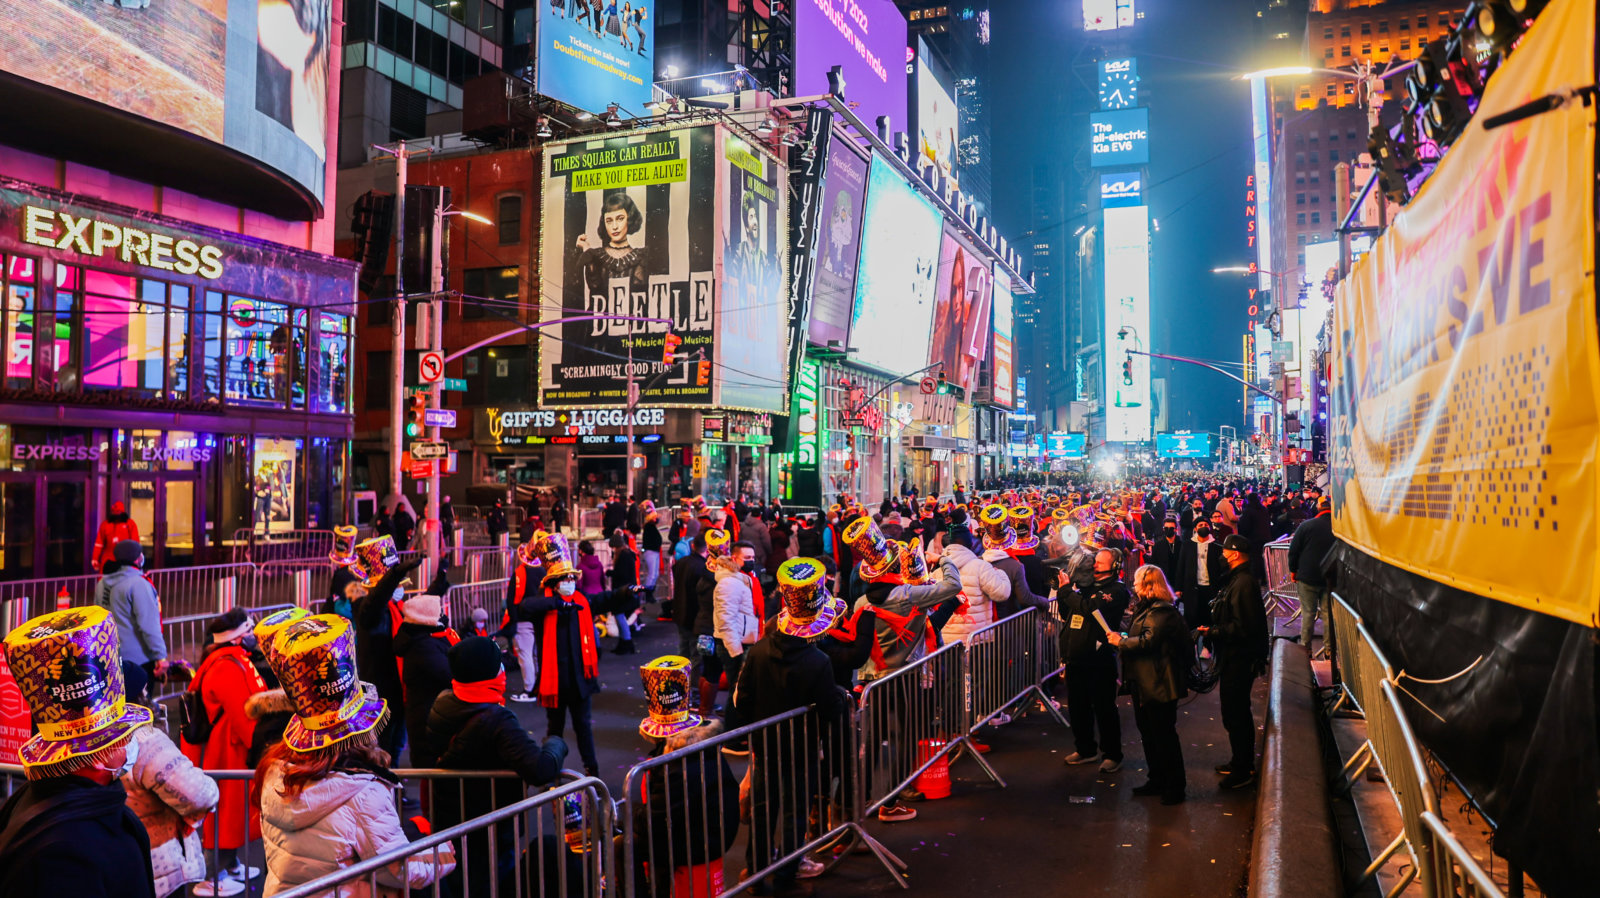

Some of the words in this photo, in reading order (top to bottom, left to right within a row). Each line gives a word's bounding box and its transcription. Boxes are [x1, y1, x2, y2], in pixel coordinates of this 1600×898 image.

[569, 36, 592, 53] Tickets
[593, 45, 602, 55] on
[602, 48, 615, 62] sale
[615, 54, 630, 68] now!
[854, 34, 866, 58] we
[866, 49, 888, 83] make
[553, 40, 643, 86] DoubtfireBroadway.com
[1092, 123, 1112, 133] The
[1093, 130, 1146, 143] all-electric
[553, 156, 580, 172] TIMES
[582, 151, 617, 168] SQUARE
[619, 148, 638, 162] CAN
[640, 140, 676, 159] REALLY
[1093, 144, 1110, 153] Kia
[1111, 141, 1132, 152] EV6
[575, 172, 602, 188] MAKE
[605, 170, 623, 184] YOU
[626, 167, 650, 182] FEEL
[653, 163, 684, 179] ALIVE!
[797, 182, 813, 248] MAC
[1246, 175, 1256, 247] ERNST
[24, 204, 224, 280] EXPRESS
[789, 254, 804, 320] MAC
[591, 275, 712, 337] BEETLE
[621, 339, 634, 348] The
[624, 362, 648, 375] GOOD
[681, 387, 709, 395] BROADWAY
[501, 411, 556, 428] GIFTS
[570, 409, 665, 426] LUGGAGE
[578, 426, 596, 435] NY
[582, 435, 610, 444] SONY
[13, 444, 100, 461] EXPRESS
[142, 447, 211, 462] EXPRESS
[52, 674, 98, 696] planet
[59, 680, 106, 702] fitness
[320, 671, 351, 693] planet
[17, 728, 31, 738] YOU
[53, 727, 76, 738] NEW
[77, 719, 105, 734] YEARS
[105, 712, 119, 724] EVE
[59, 719, 85, 731] TIMES
[319, 719, 336, 728] NEW
